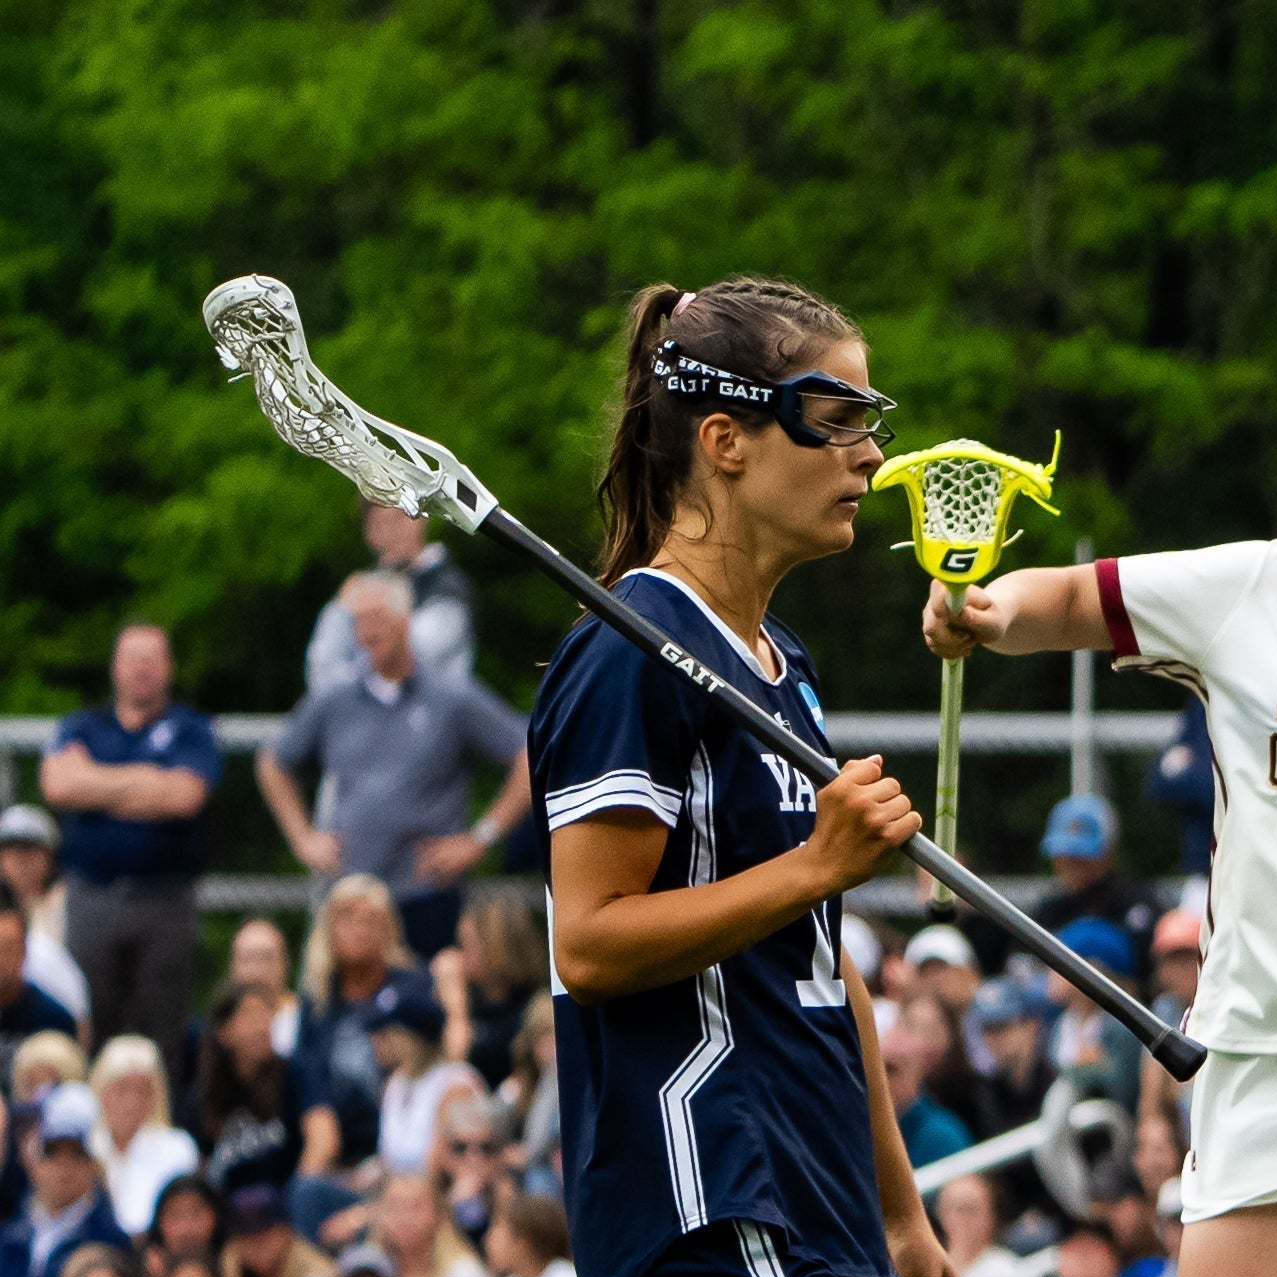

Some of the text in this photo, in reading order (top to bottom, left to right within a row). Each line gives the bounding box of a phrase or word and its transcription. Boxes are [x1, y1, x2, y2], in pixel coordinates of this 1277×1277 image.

[719, 381, 773, 402] GAIT
[660, 642, 725, 693] GAIT
[761, 754, 830, 812] YA
